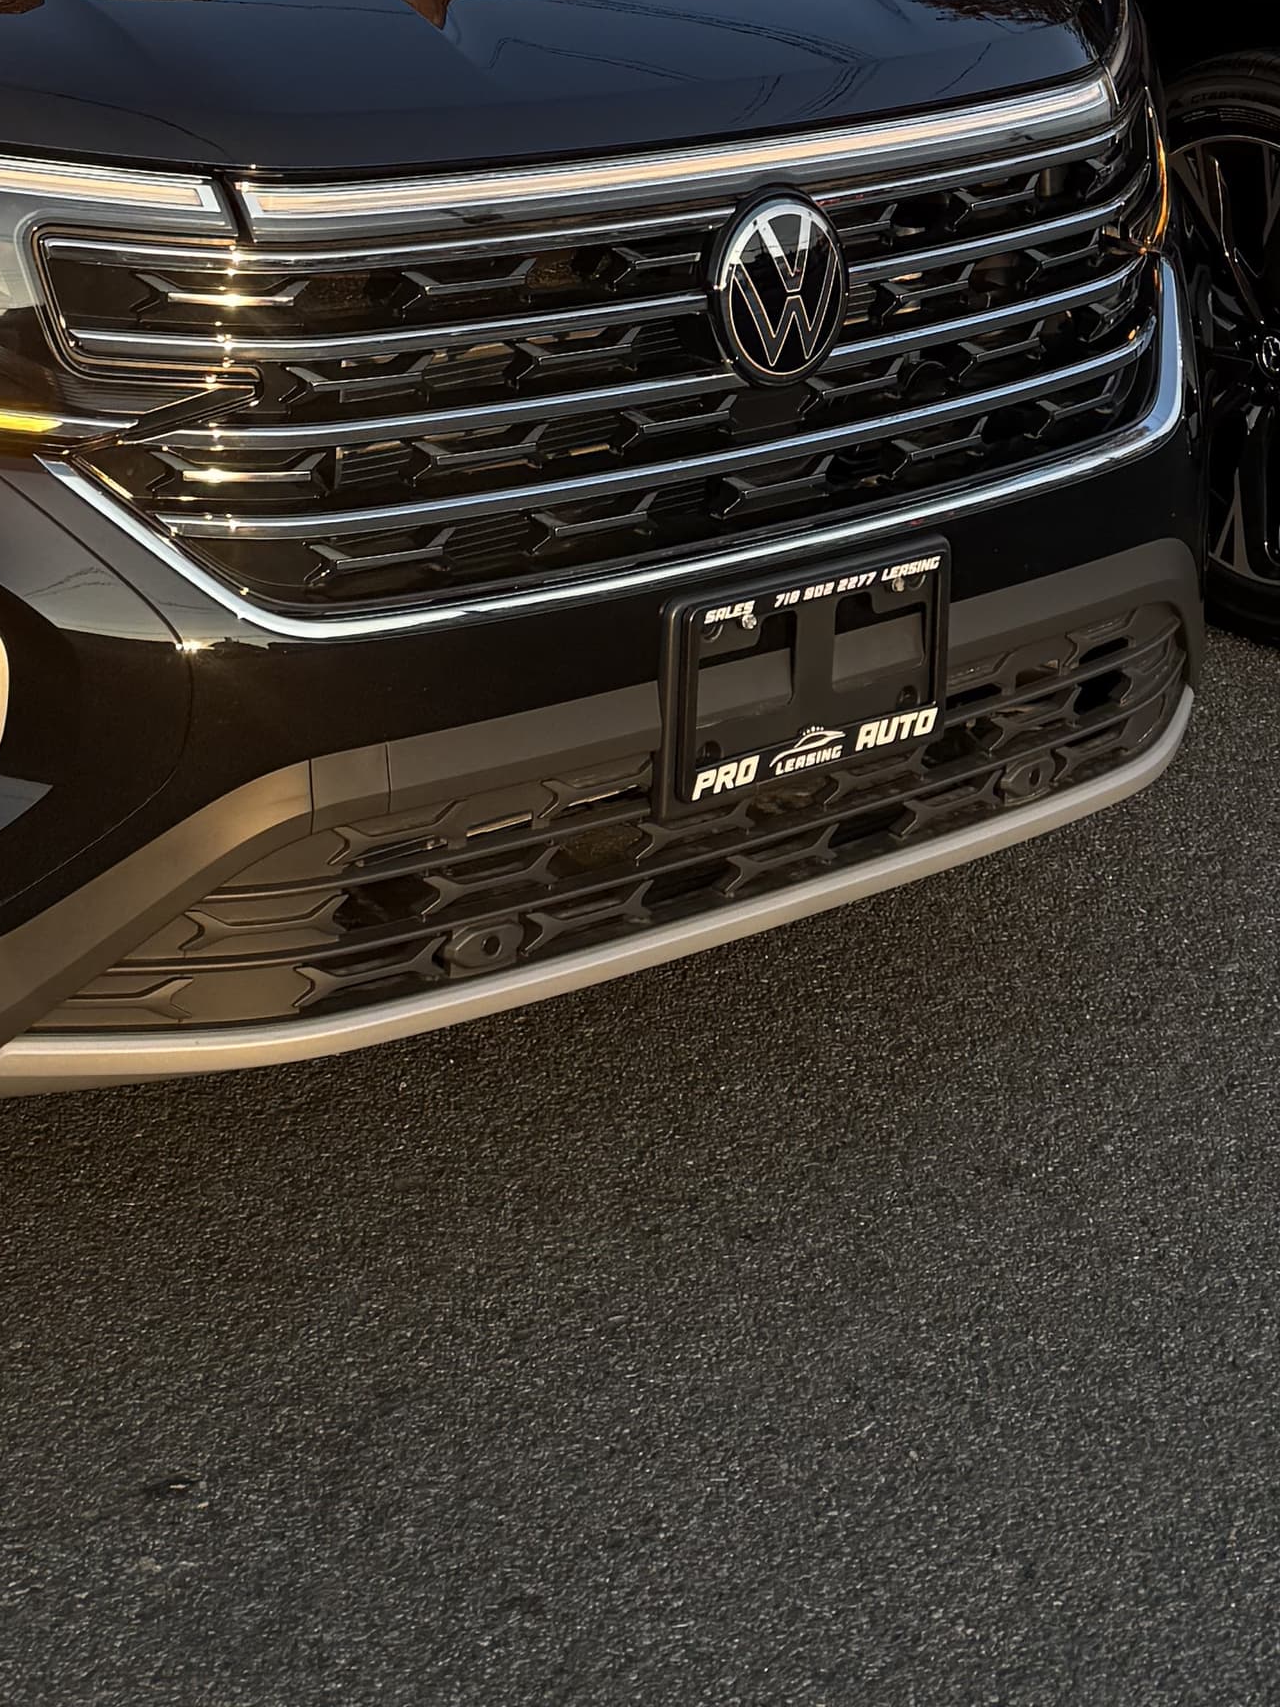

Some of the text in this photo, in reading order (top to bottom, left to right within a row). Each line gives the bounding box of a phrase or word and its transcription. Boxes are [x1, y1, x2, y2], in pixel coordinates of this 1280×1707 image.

[703, 600, 756, 625] SALES
[880, 555, 942, 581] LEASING
[689, 706, 938, 802] PRO LEASING AUTO
